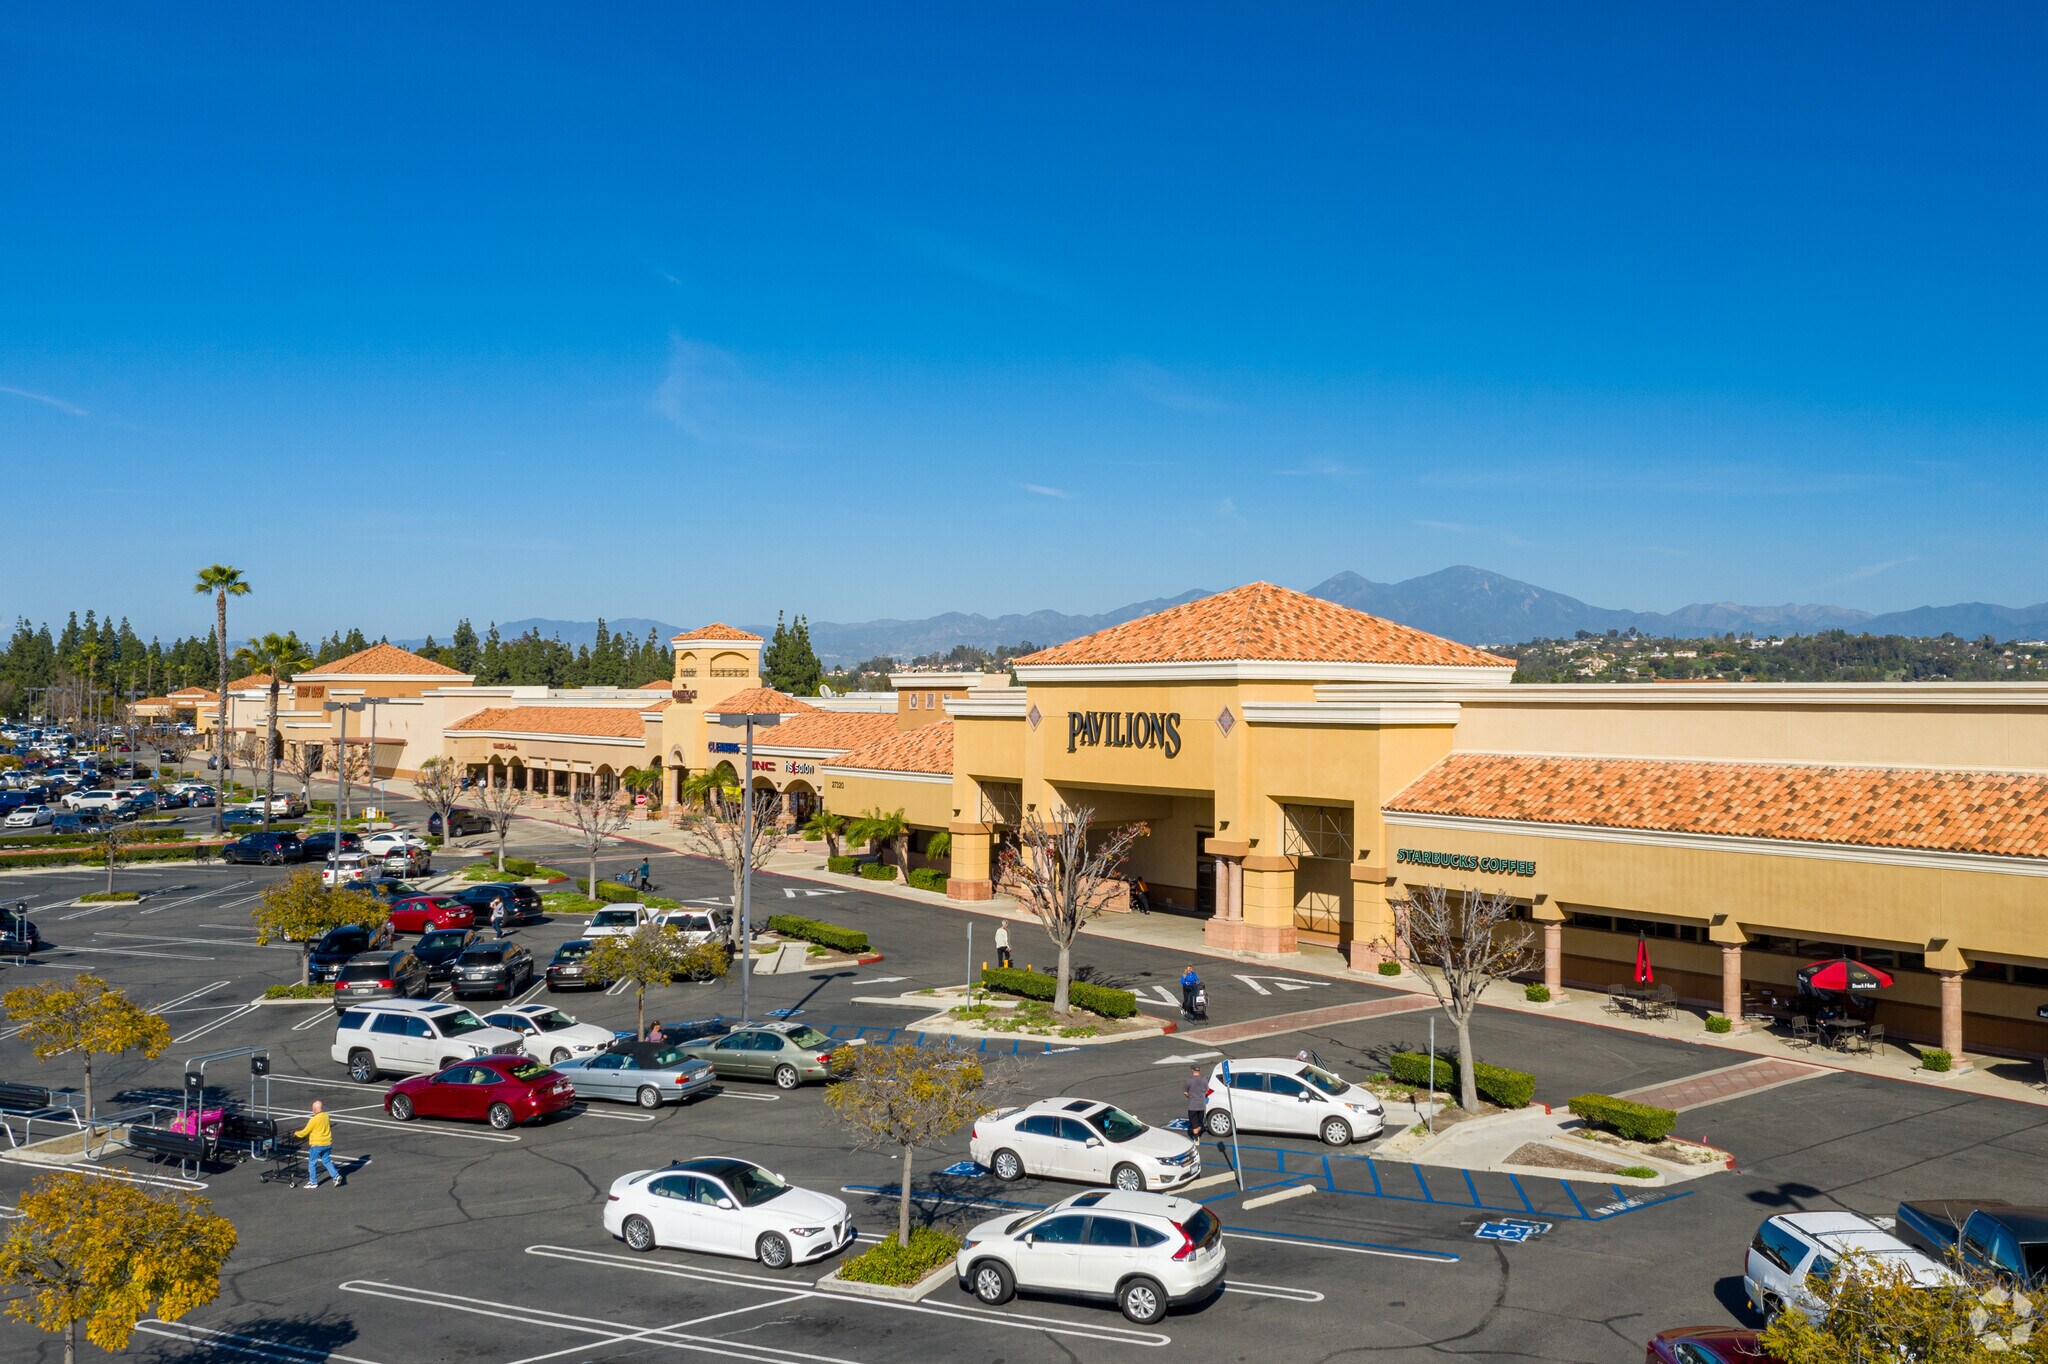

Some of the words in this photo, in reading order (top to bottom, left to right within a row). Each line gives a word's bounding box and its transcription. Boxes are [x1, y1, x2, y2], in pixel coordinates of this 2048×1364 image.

[1067, 711, 1182, 759] PAVILIONS
[708, 741, 740, 754] CLEANERS
[751, 760, 777, 772] NC
[1397, 848, 1478, 870] STARBUCKS
[1479, 857, 1536, 877] COFFEE
